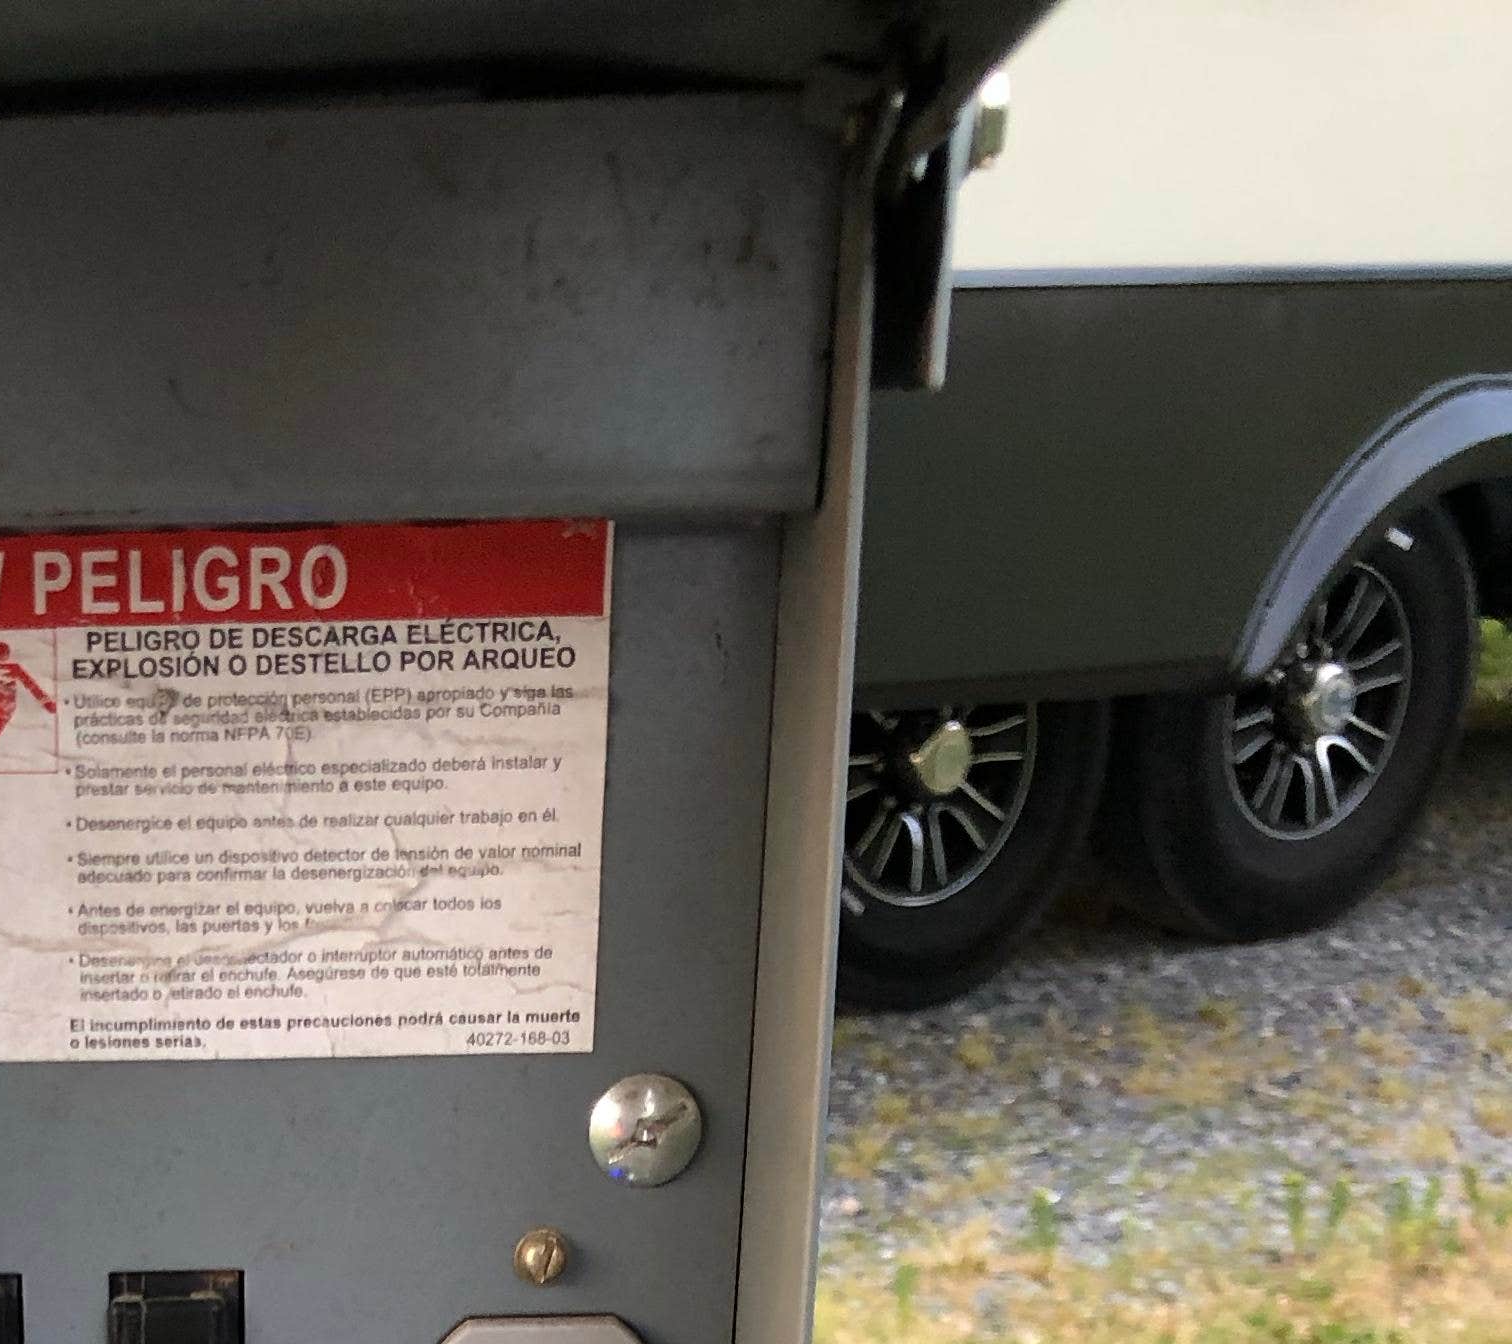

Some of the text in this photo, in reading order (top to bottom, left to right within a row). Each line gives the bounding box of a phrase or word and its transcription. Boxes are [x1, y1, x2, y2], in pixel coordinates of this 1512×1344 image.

[33, 545, 349, 616] PELIGRO
[86, 619, 561, 652] PELIGRO DE DESCARGA ELÉCTRICA,
[72, 646, 576, 679] EXPLOSIÓN O DESTELLO POR ARQUEO
[224, 728, 270, 741] NFPA
[215, 1017, 235, 1031] de
[507, 1010, 520, 1024] la
[525, 1009, 581, 1024] muerte
